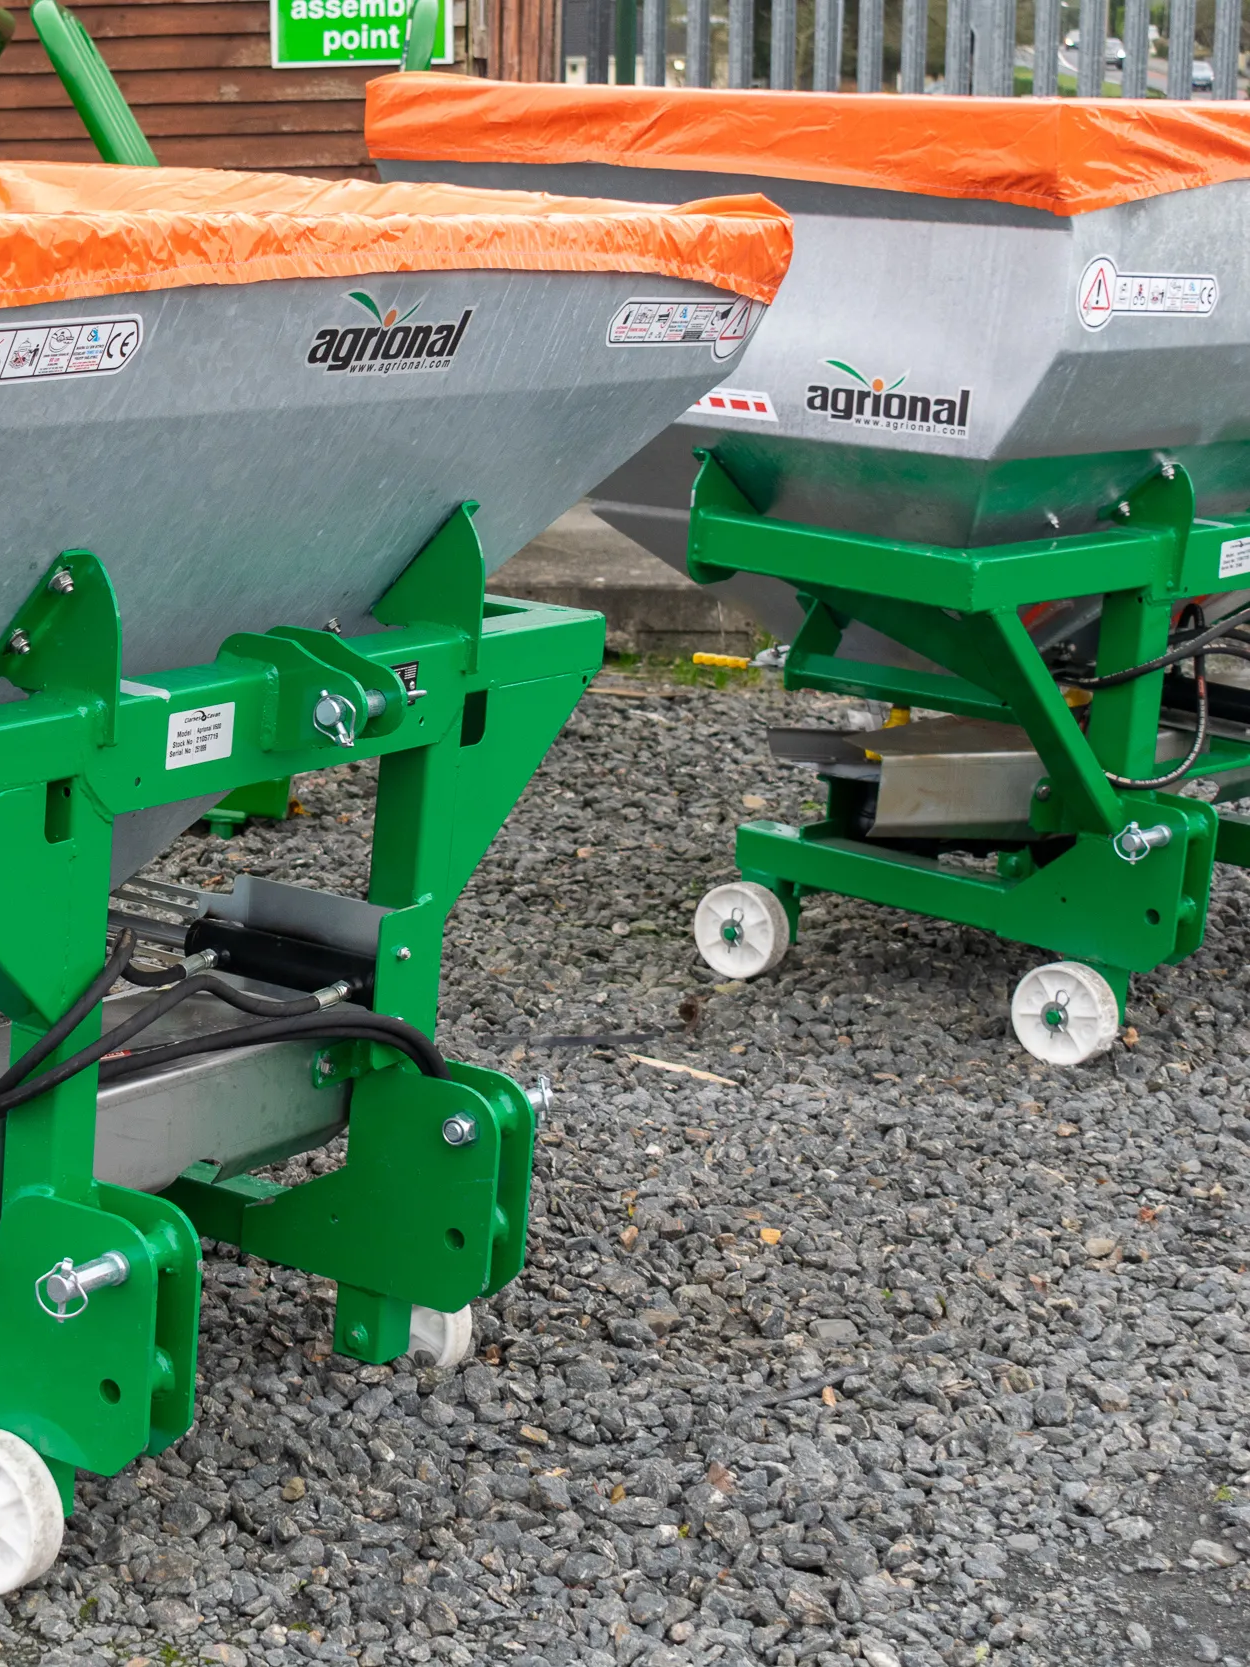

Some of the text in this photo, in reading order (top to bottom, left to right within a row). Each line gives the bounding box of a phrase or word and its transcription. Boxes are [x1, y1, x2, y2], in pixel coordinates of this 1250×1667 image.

[323, 24, 400, 56] point
[307, 309, 473, 371] agrional
[350, 359, 450, 373] www.agrional.com
[806, 385, 970, 427] agrional
[854, 417, 966, 437] www.agrional.com
[177, 729, 192, 738] Model
[172, 740, 185, 749] Stock
[186, 738, 193, 746] No
[169, 748, 183, 758] Serial
[184, 747, 191, 755] No
